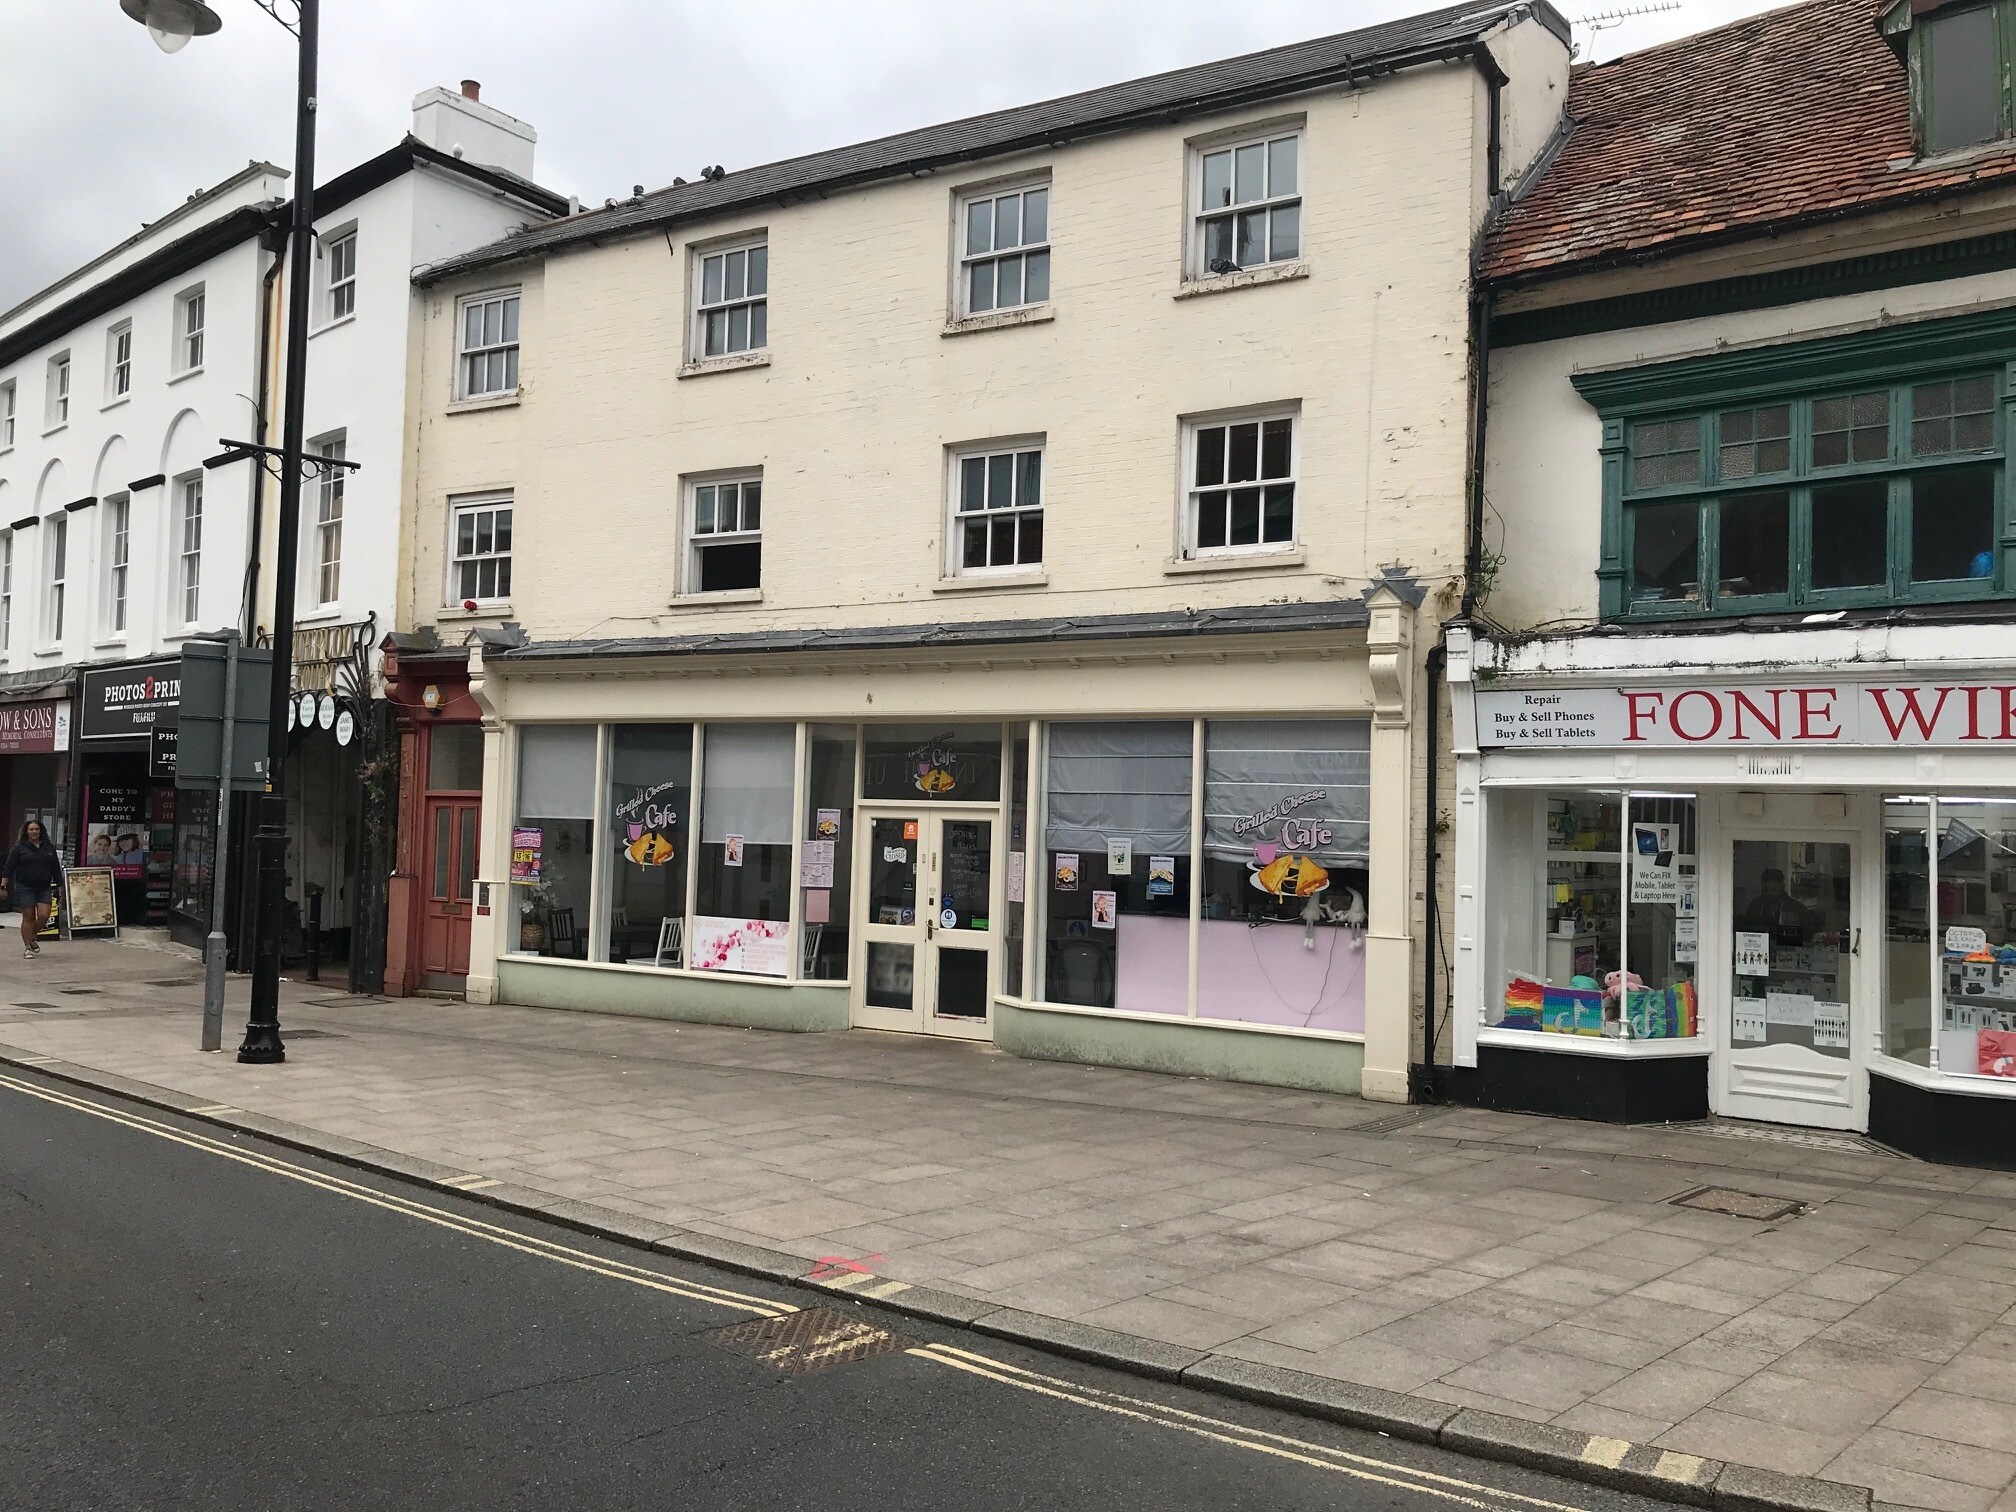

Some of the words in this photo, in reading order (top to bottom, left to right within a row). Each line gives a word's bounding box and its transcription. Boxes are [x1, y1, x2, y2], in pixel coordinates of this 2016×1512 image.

[1524, 694, 1562, 706] Repair
[14, 710, 20, 730] &
[24, 706, 52, 730] SONS
[1494, 712, 1515, 724] Buy
[1518, 712, 1528, 722] &
[1531, 712, 1552, 722] Sell
[1554, 711, 1594, 721] Phones
[1621, 688, 1843, 741] FONE
[1496, 729, 1516, 740] Buy
[1520, 728, 1529, 738] &
[1532, 728, 1552, 738] Sell
[1555, 728, 1596, 738] Tablets
[932, 748, 957, 767] Cafe
[616, 793, 644, 819] Grilled
[644, 781, 674, 802] Cheese
[644, 804, 677, 830] Cafe
[1233, 804, 1279, 837] Grilled
[1280, 788, 1326, 816] Cheese
[1281, 818, 1332, 850] Cafe
[885, 852, 905, 860] CLOSED
[1634, 882, 1657, 890] Mobile,
[1658, 882, 1676, 890] Tablet
[1640, 892, 1662, 900] Laptop
[1948, 930, 1982, 938] OCTOPUS
